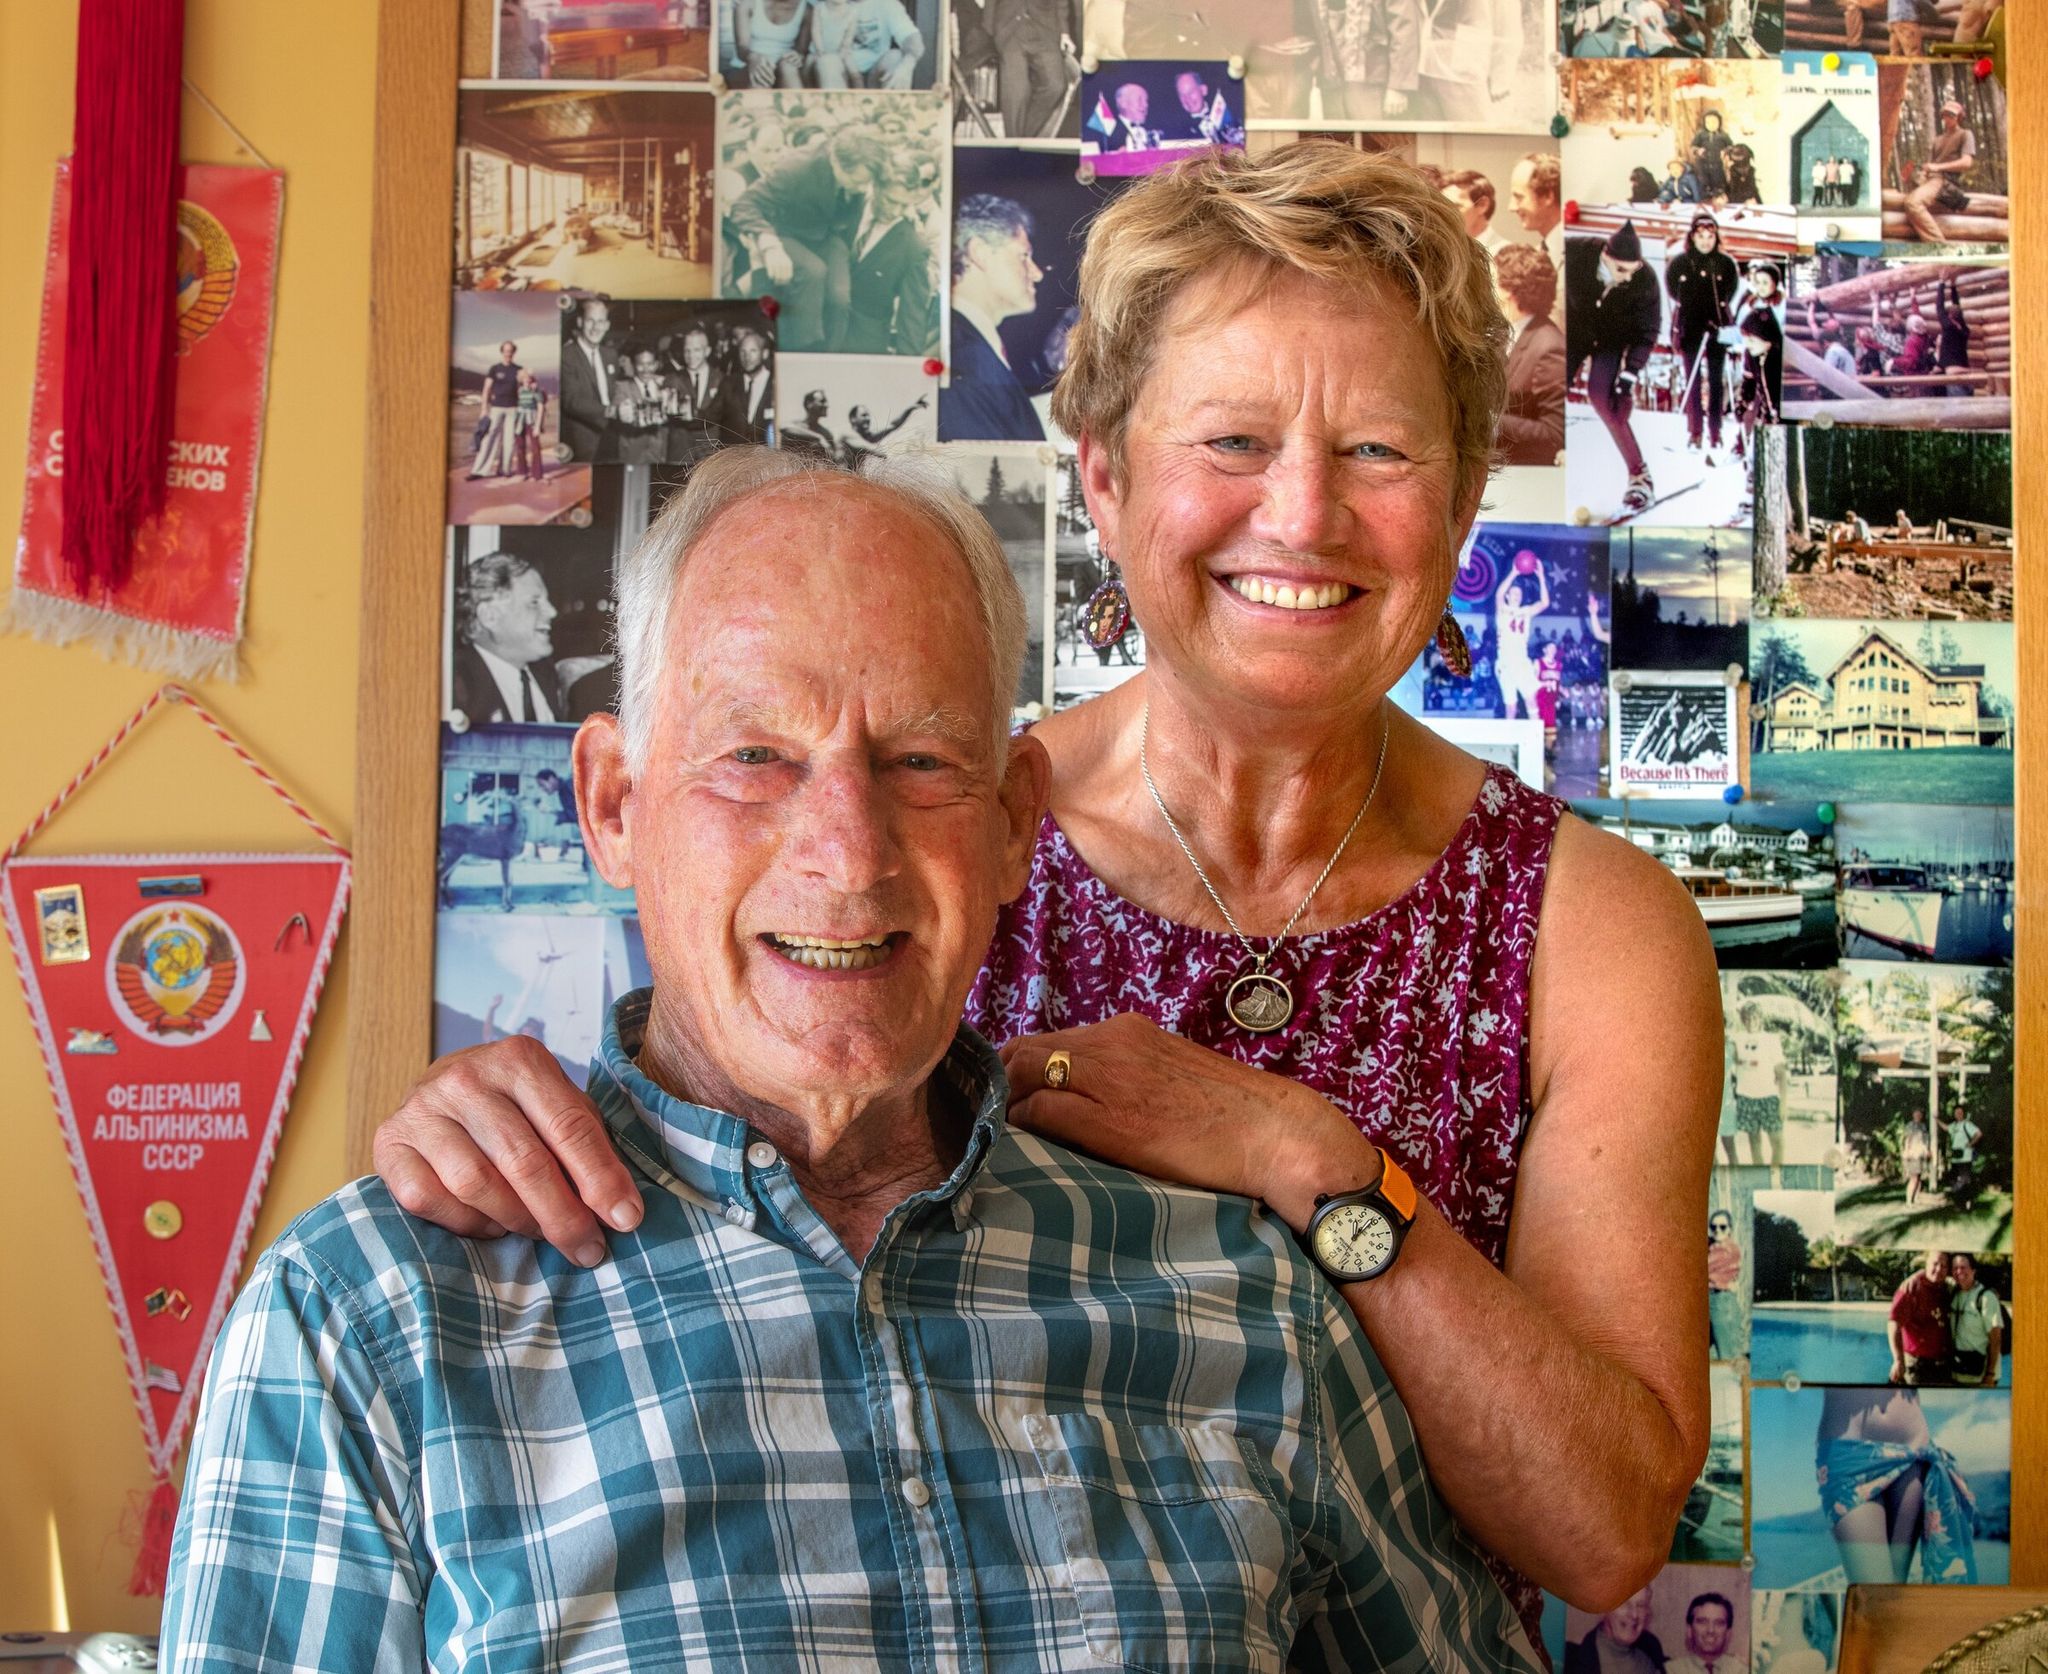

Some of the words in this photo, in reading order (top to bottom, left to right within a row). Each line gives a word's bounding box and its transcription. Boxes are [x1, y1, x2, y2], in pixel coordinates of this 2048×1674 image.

[1509, 618, 1525, 634] 44
[1620, 765, 1672, 780] Because
[1692, 766, 1728, 781] There
[106, 1082, 241, 1112] ФЕДЕРАЦИЯ
[92, 1113, 250, 1142] АЛЬПИНИЗМА
[142, 1143, 205, 1171] СССР
